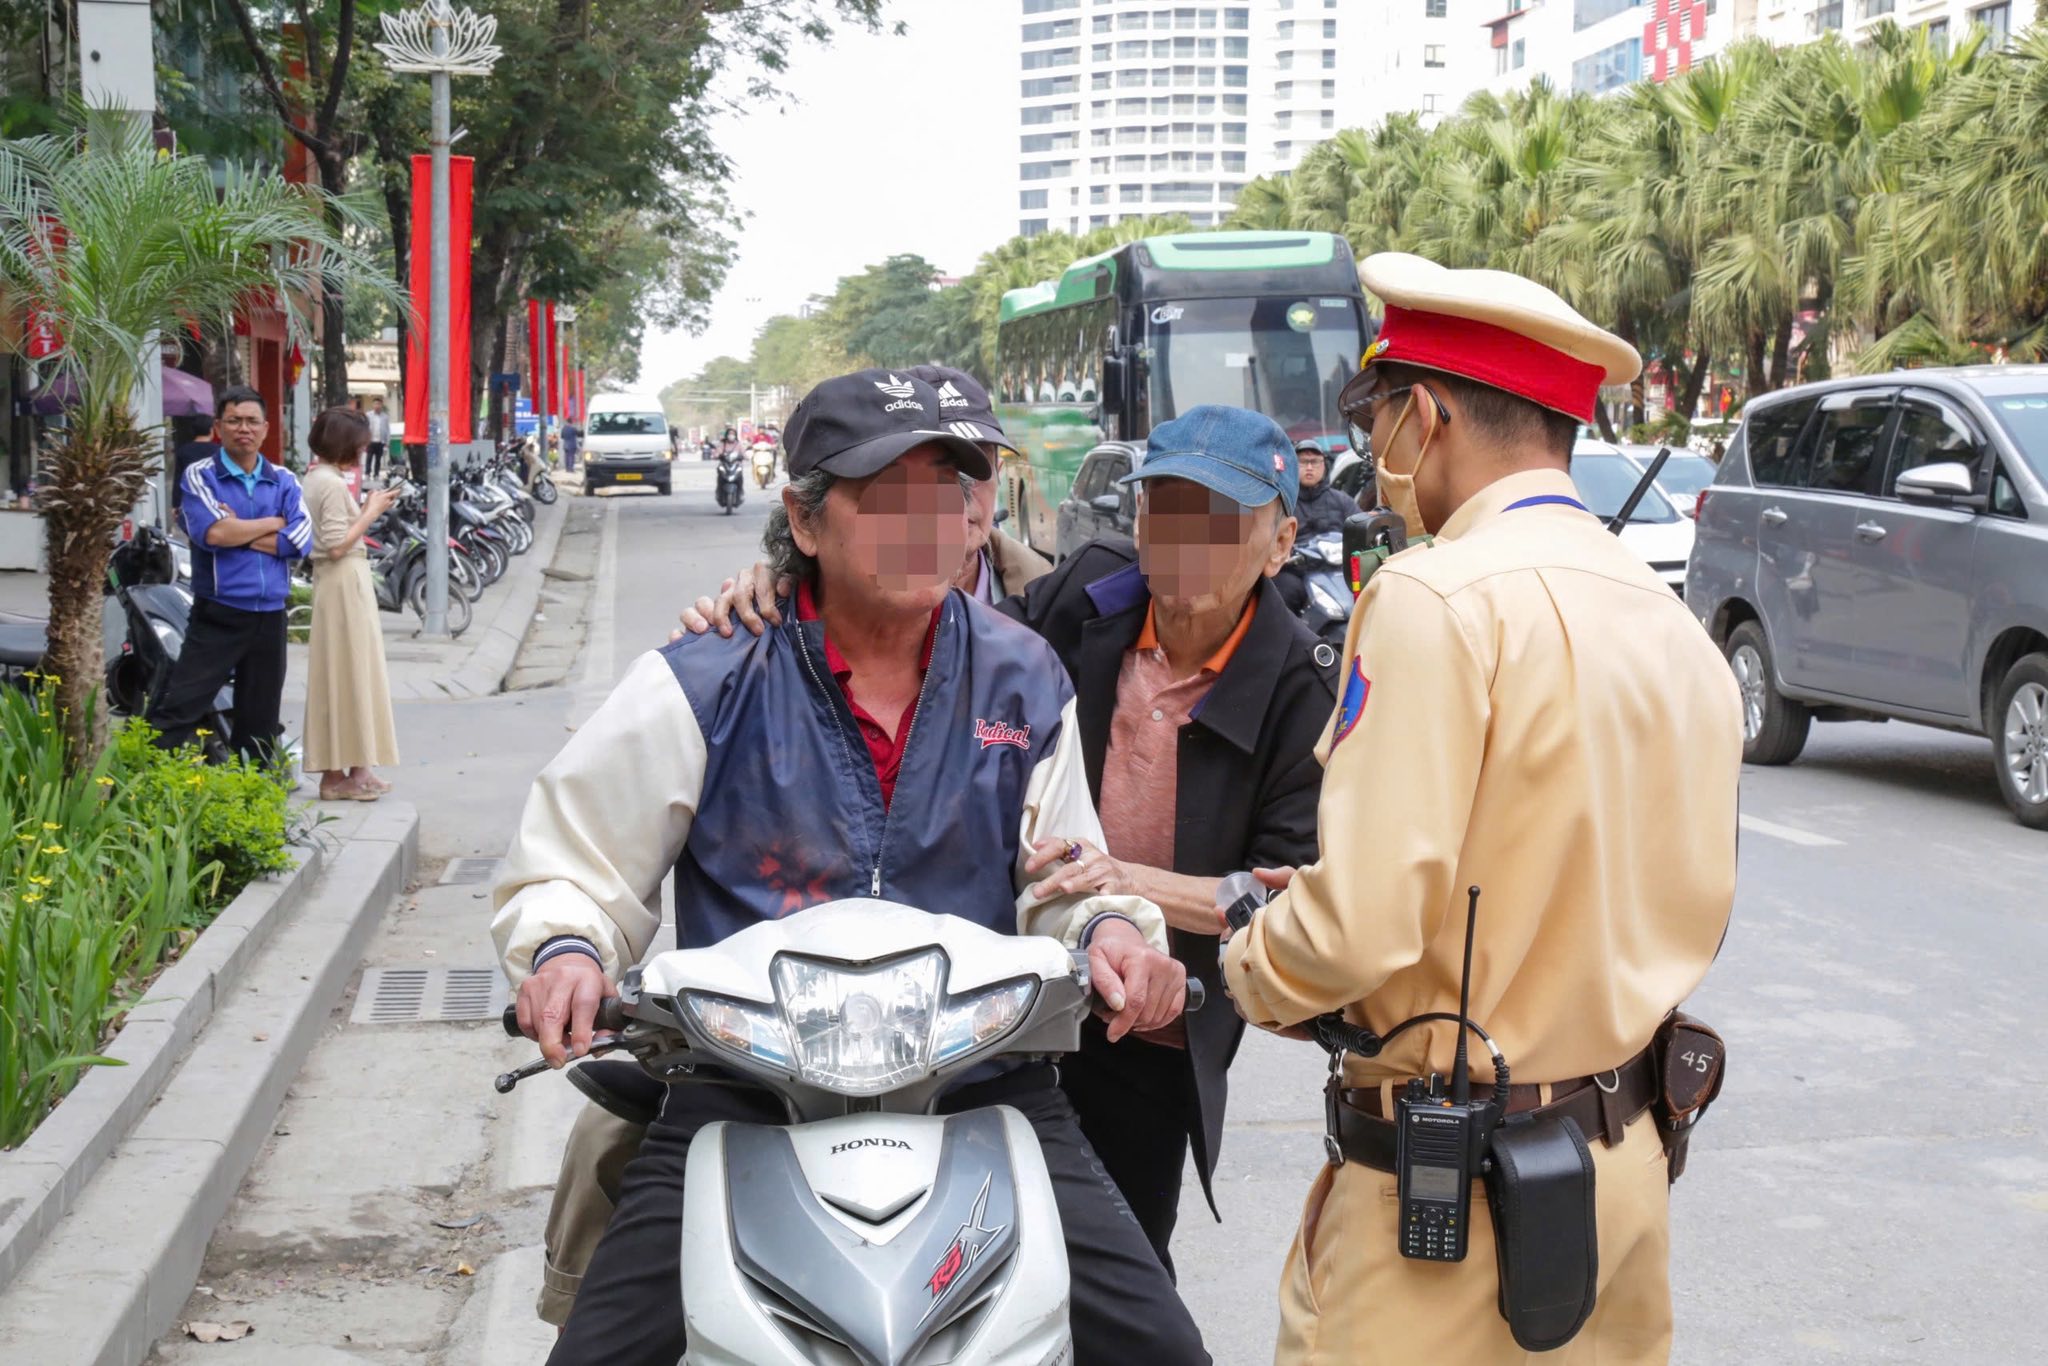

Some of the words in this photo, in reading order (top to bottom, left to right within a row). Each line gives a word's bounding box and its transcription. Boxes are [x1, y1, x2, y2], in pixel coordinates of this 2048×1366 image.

[885, 399, 924, 412] adidas
[940, 398, 969, 407] didas
[974, 718, 1031, 745] Radical
[1680, 1050, 1713, 1073] 45
[1422, 1117, 1460, 1125] MOTOROLA
[831, 1137, 914, 1155] HONDA
